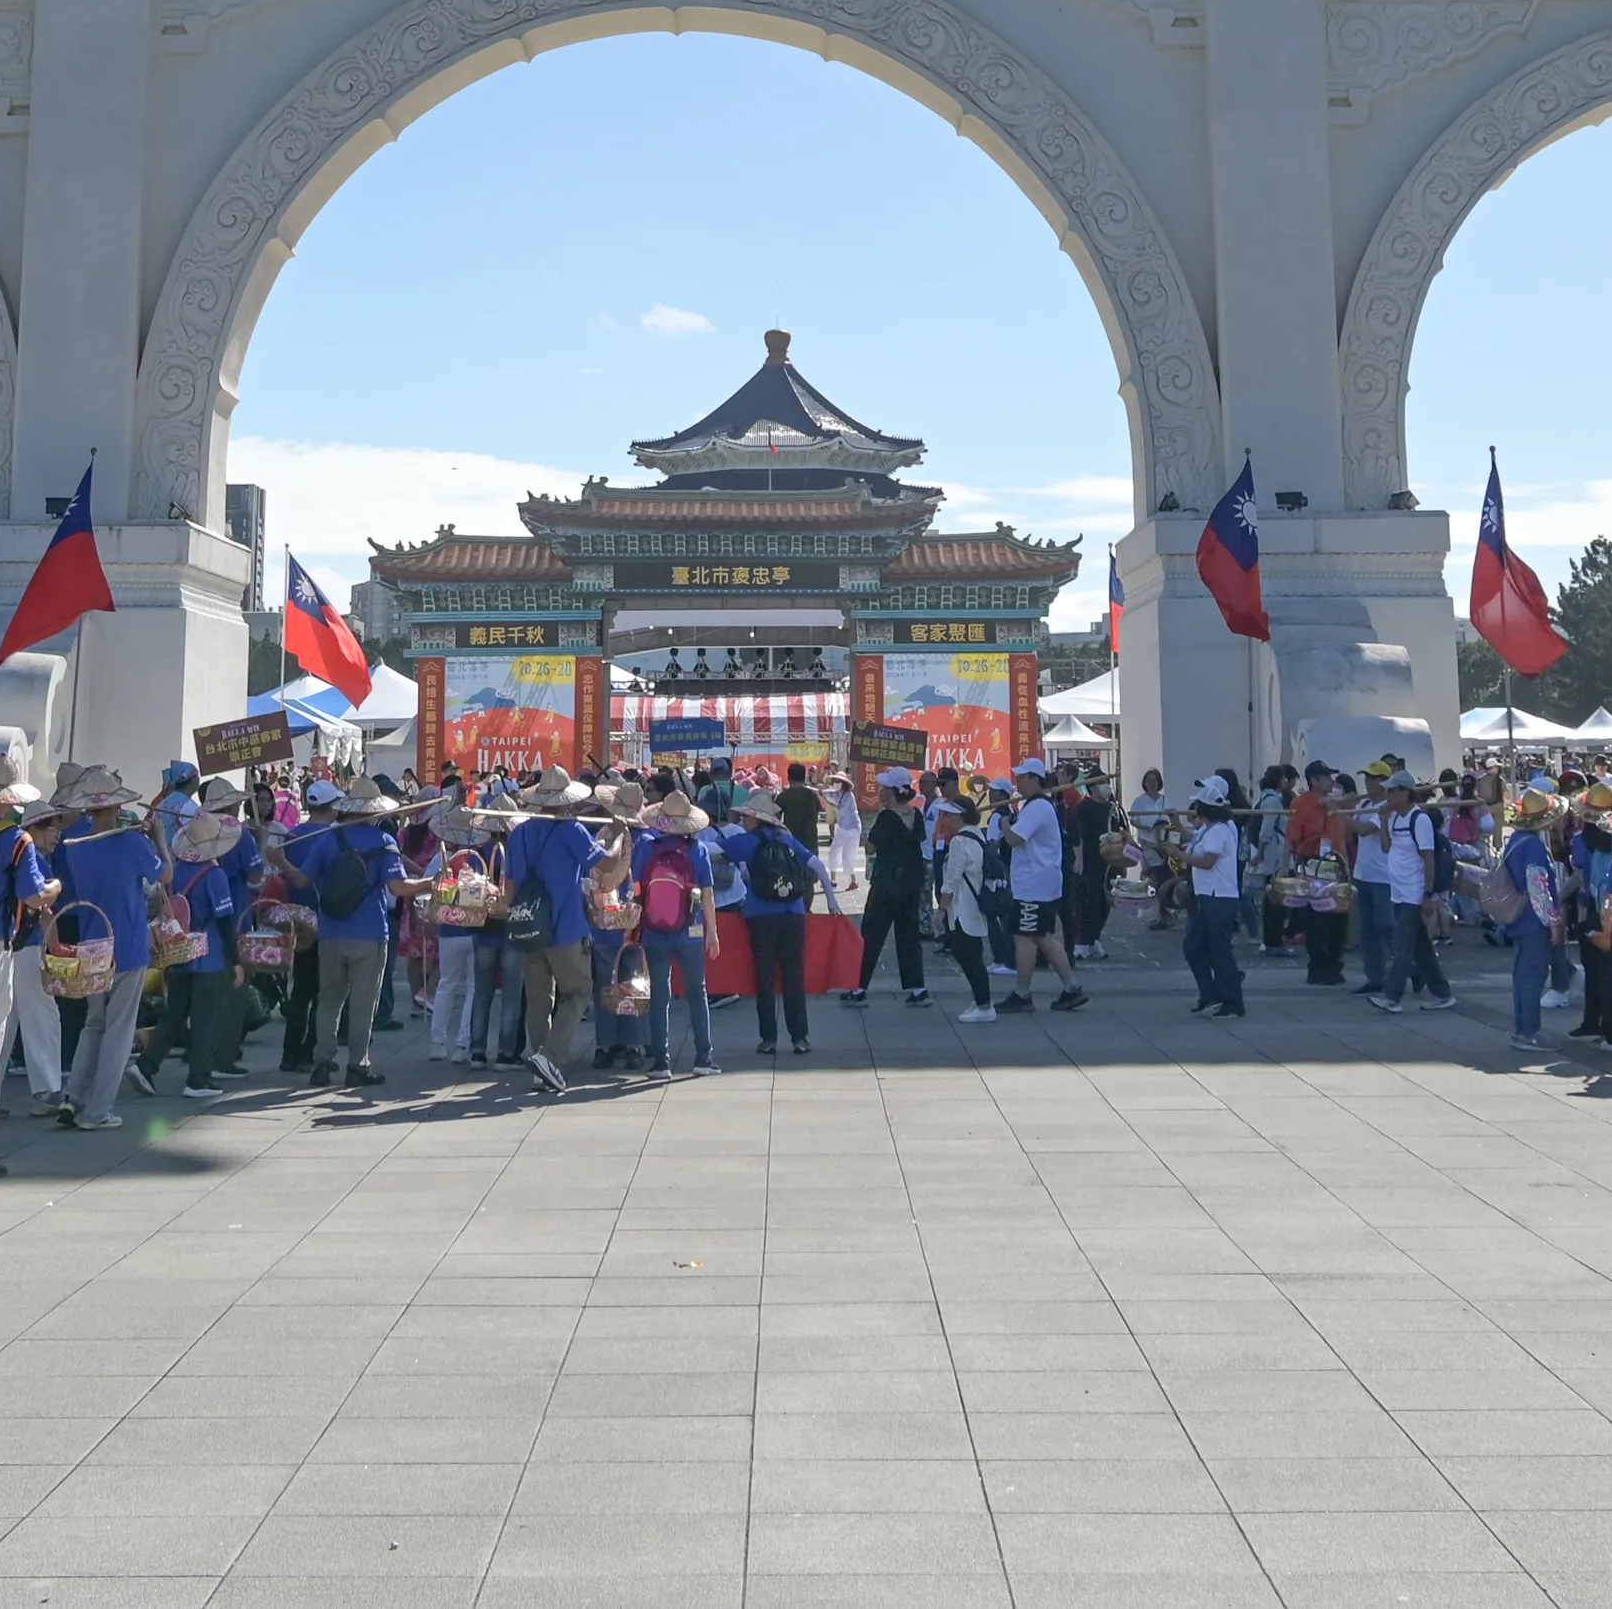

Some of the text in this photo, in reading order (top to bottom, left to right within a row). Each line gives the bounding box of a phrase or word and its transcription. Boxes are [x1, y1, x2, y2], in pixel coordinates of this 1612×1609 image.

[671, 566, 791, 585] 臺北市褒忠亭
[469, 626, 545, 645] 義民千秋
[910, 623, 986, 642] 客家聚匯
[492, 737, 532, 745] TAIPEI
[932, 734, 972, 743] TAIPEI
[478, 749, 543, 774] HAKKA
